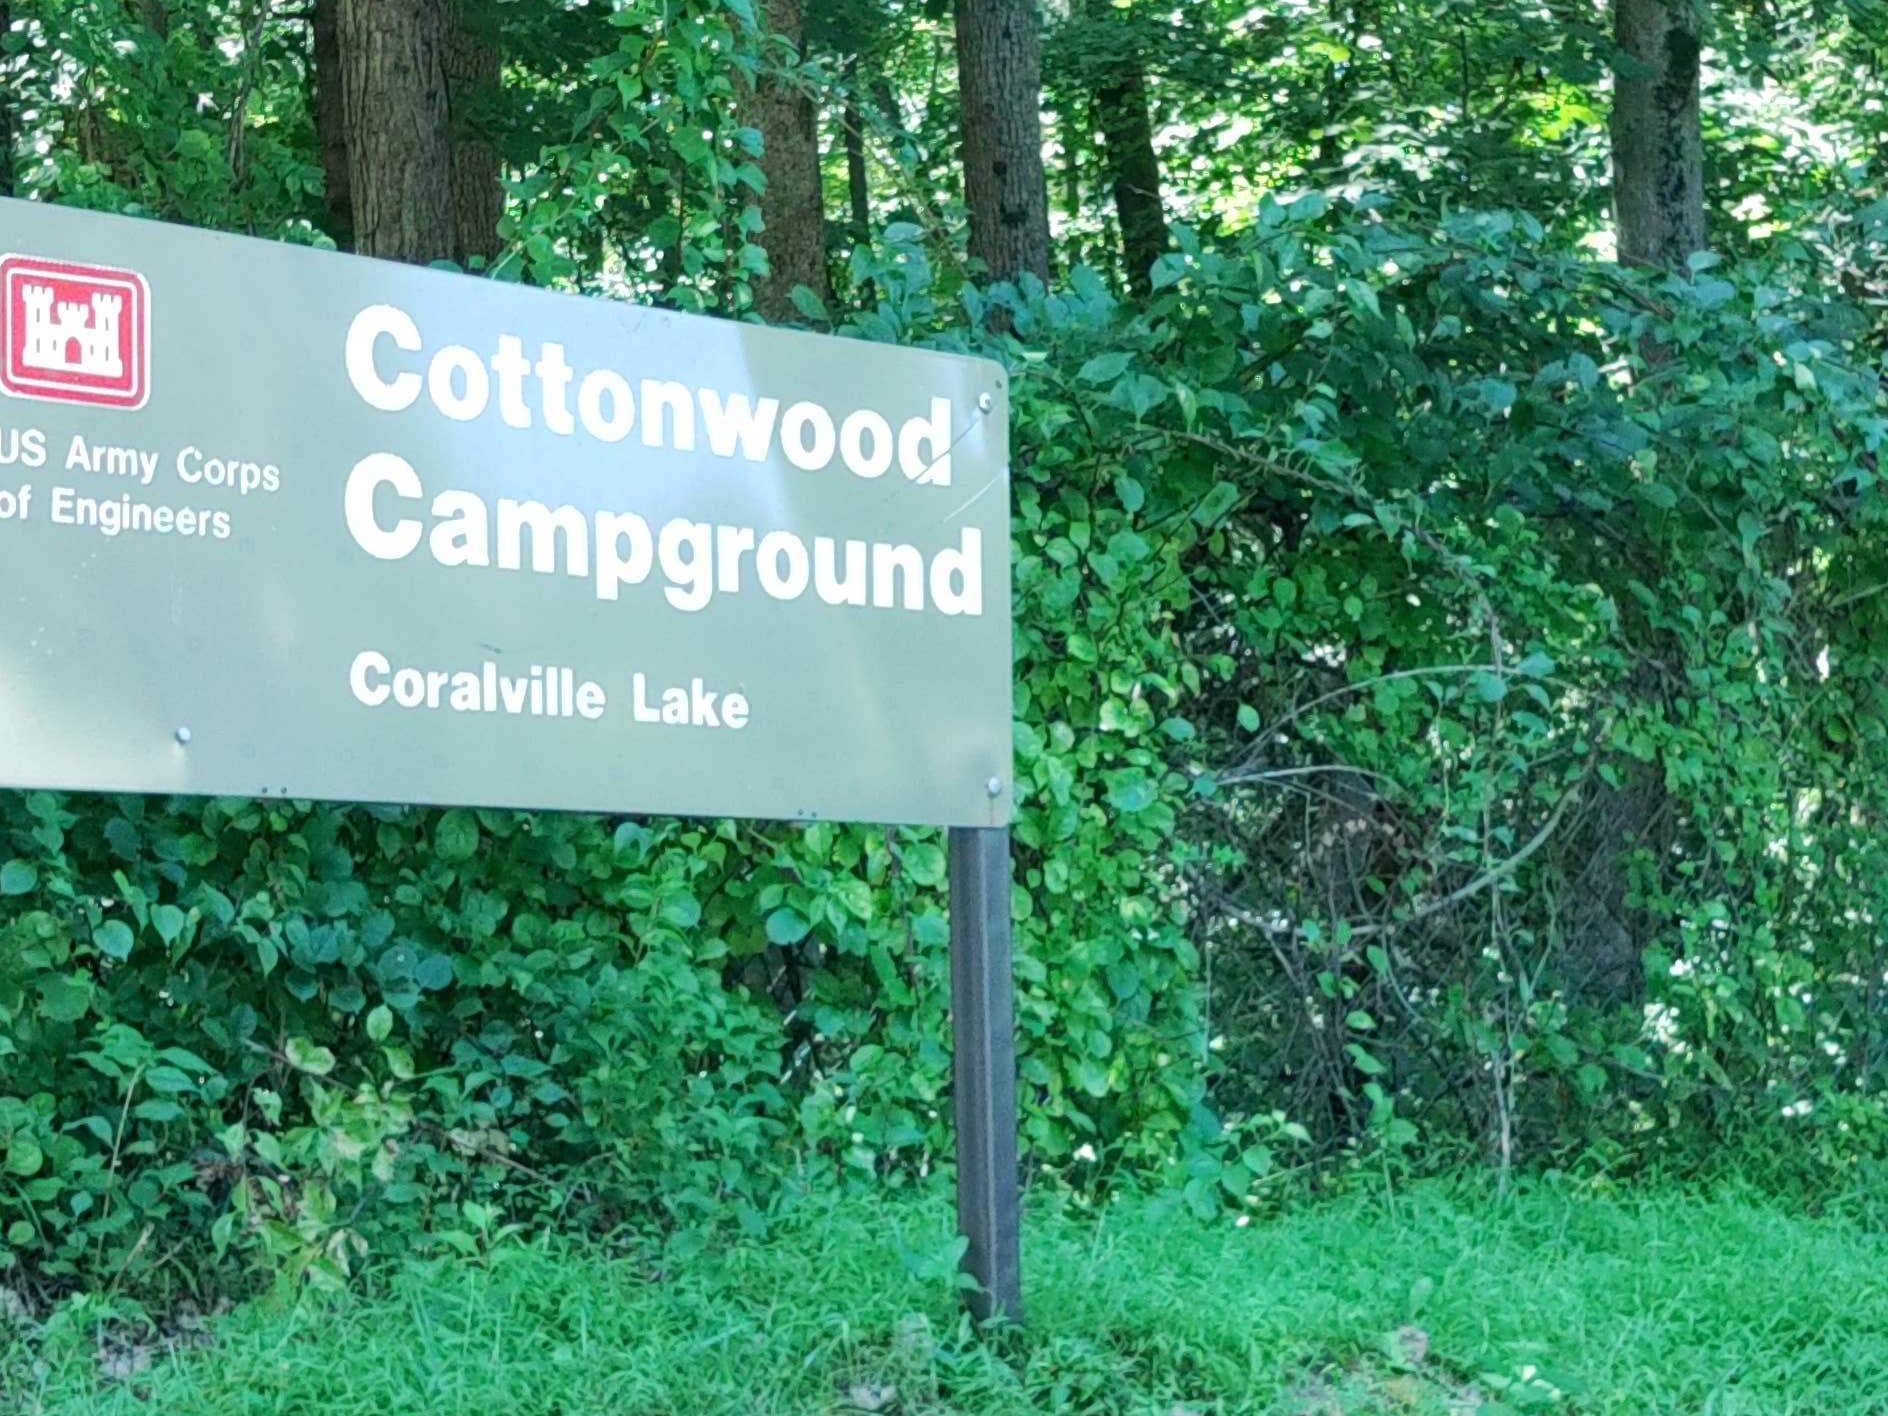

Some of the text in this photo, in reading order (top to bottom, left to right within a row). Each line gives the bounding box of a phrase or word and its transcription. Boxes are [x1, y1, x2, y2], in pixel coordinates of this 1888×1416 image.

[344, 304, 952, 487] Cottonwood
[65, 434, 158, 484] Army
[177, 446, 280, 494] Corps
[51, 487, 231, 538] Engineers
[344, 452, 984, 616] Campground
[349, 649, 750, 729] Coralville Lake
